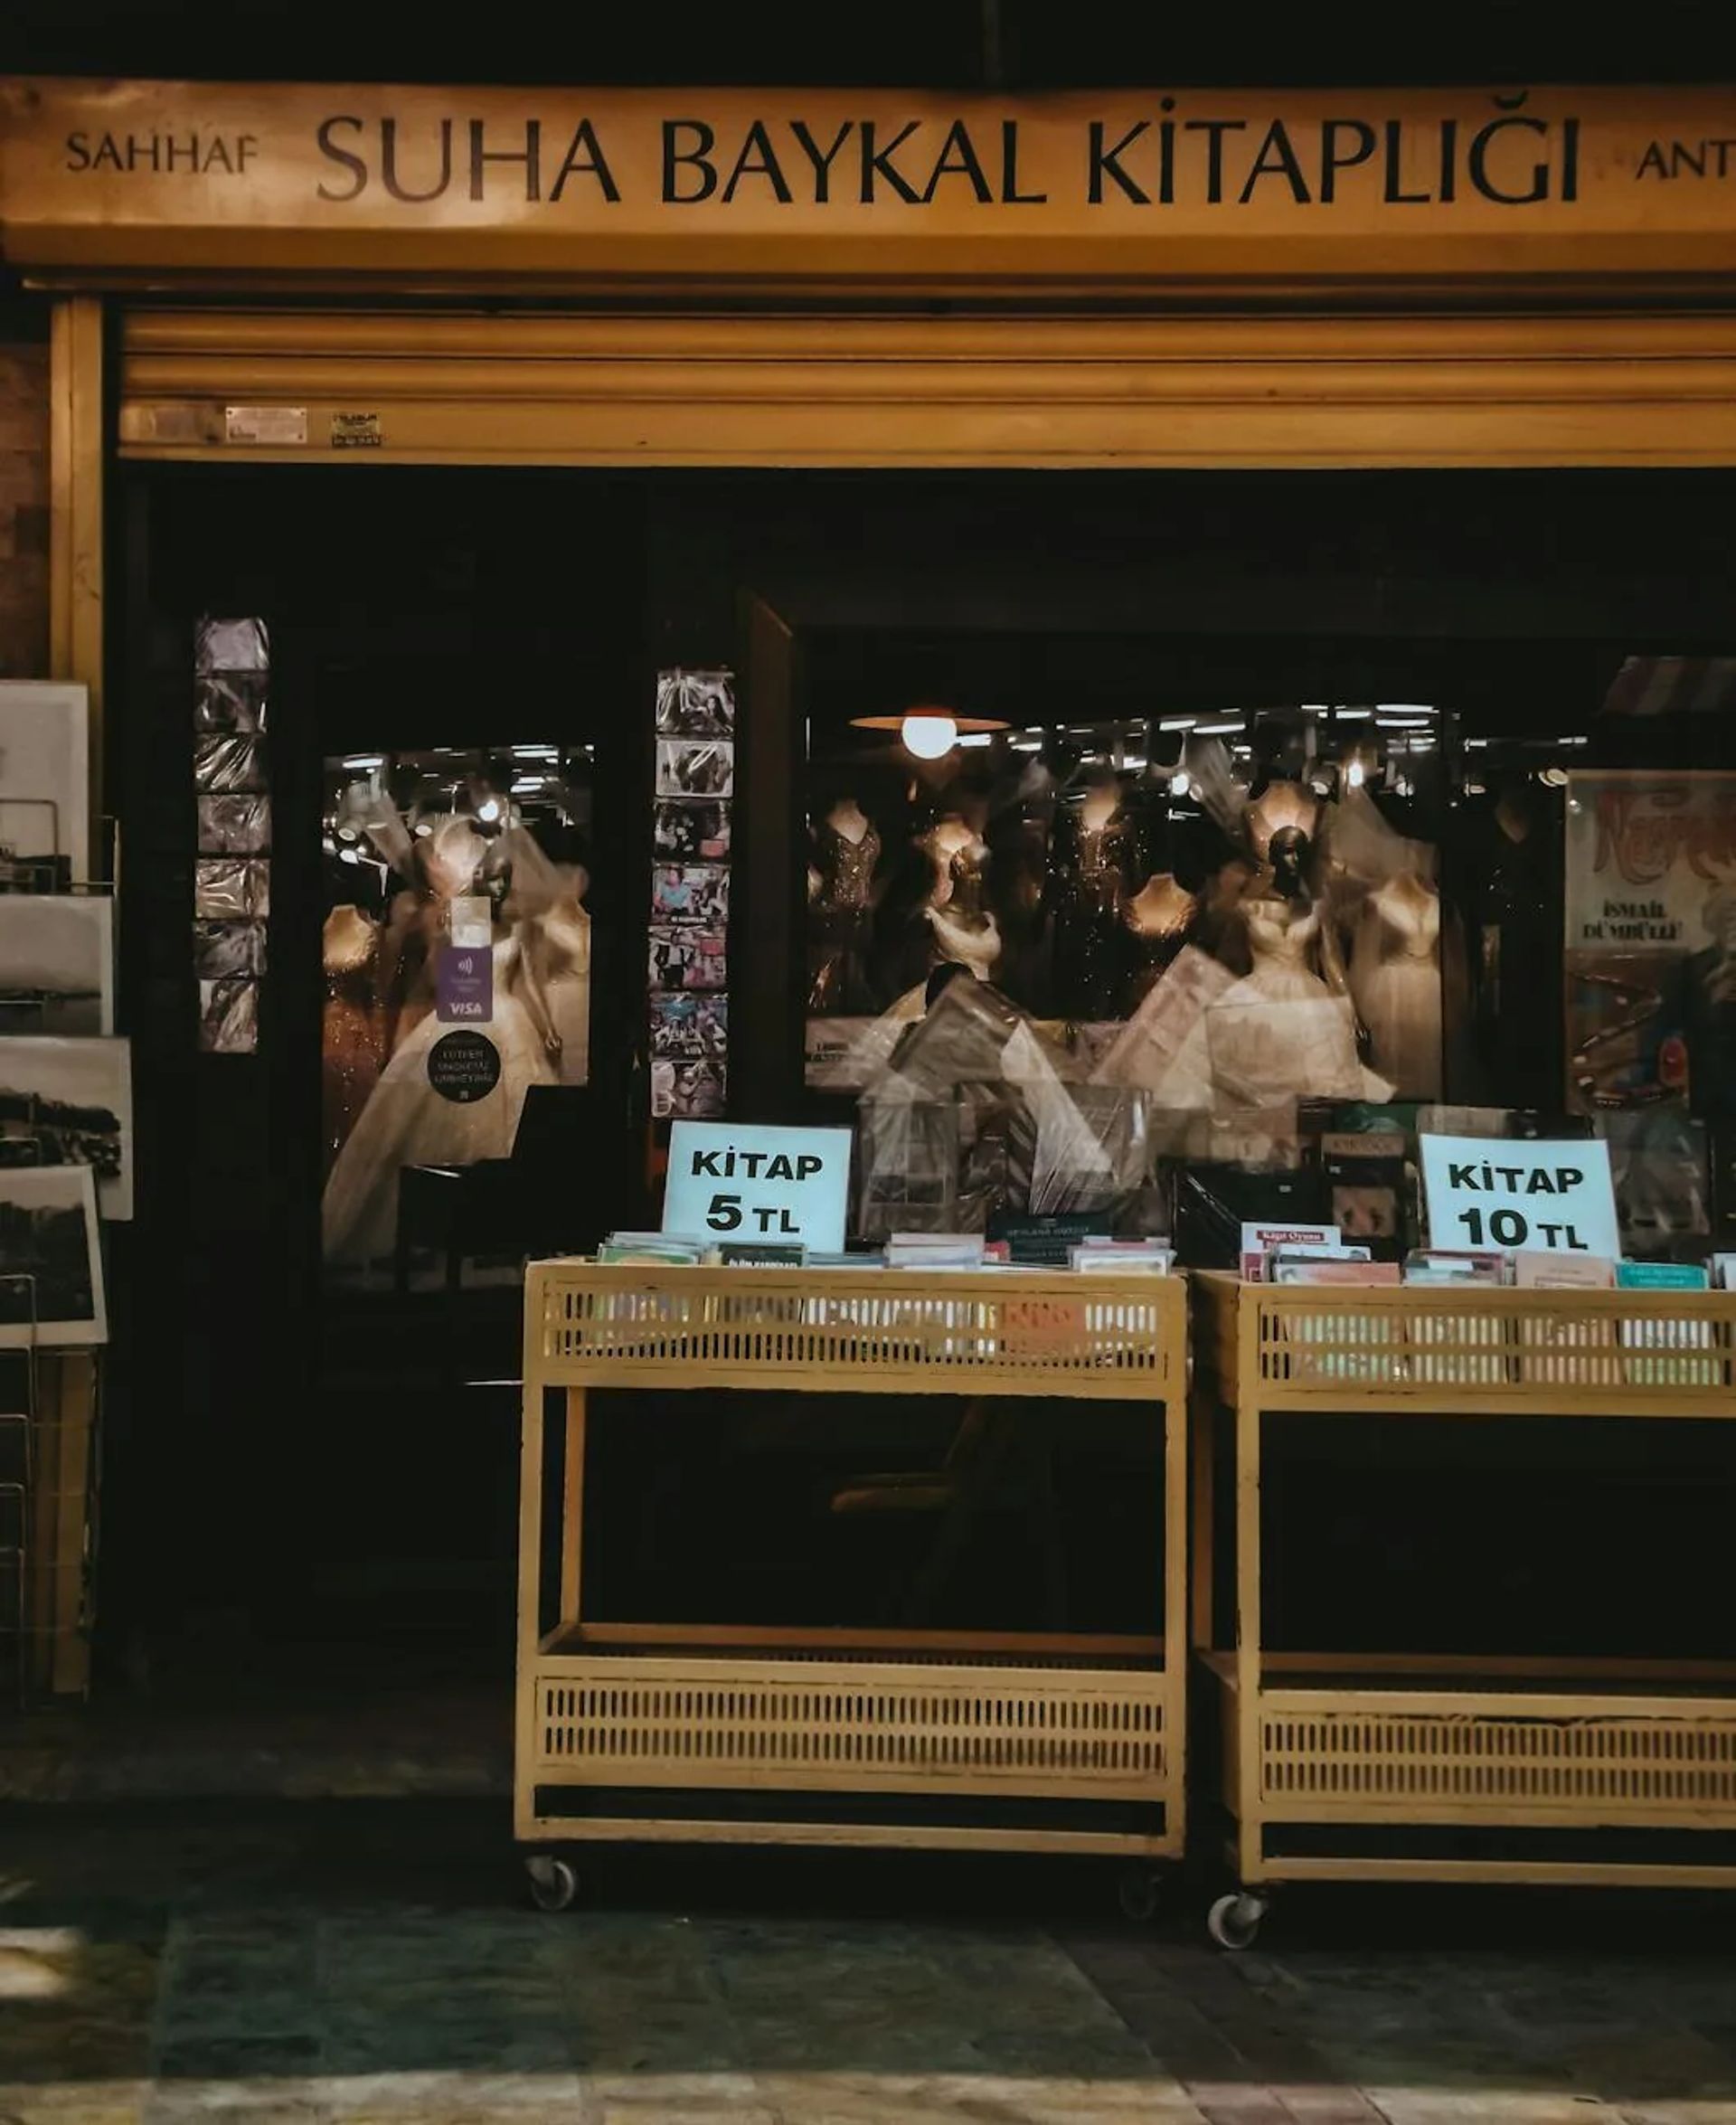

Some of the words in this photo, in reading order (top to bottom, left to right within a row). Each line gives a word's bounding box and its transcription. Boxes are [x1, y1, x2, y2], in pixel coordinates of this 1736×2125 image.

[66, 132, 259, 174] SAHHAF
[316, 115, 621, 203] SUHA
[662, 118, 1048, 204] BAYKAL
[1088, 90, 1580, 204] KİTAPLIĞI
[449, 1002, 483, 1015] VISA
[691, 1145, 823, 1181] KİTAP
[1448, 1159, 1584, 1194] KİTAP
[705, 1195, 742, 1232] 5
[751, 1207, 800, 1233] TL
[1458, 1208, 1528, 1247] 10
[1536, 1224, 1589, 1250] TL
